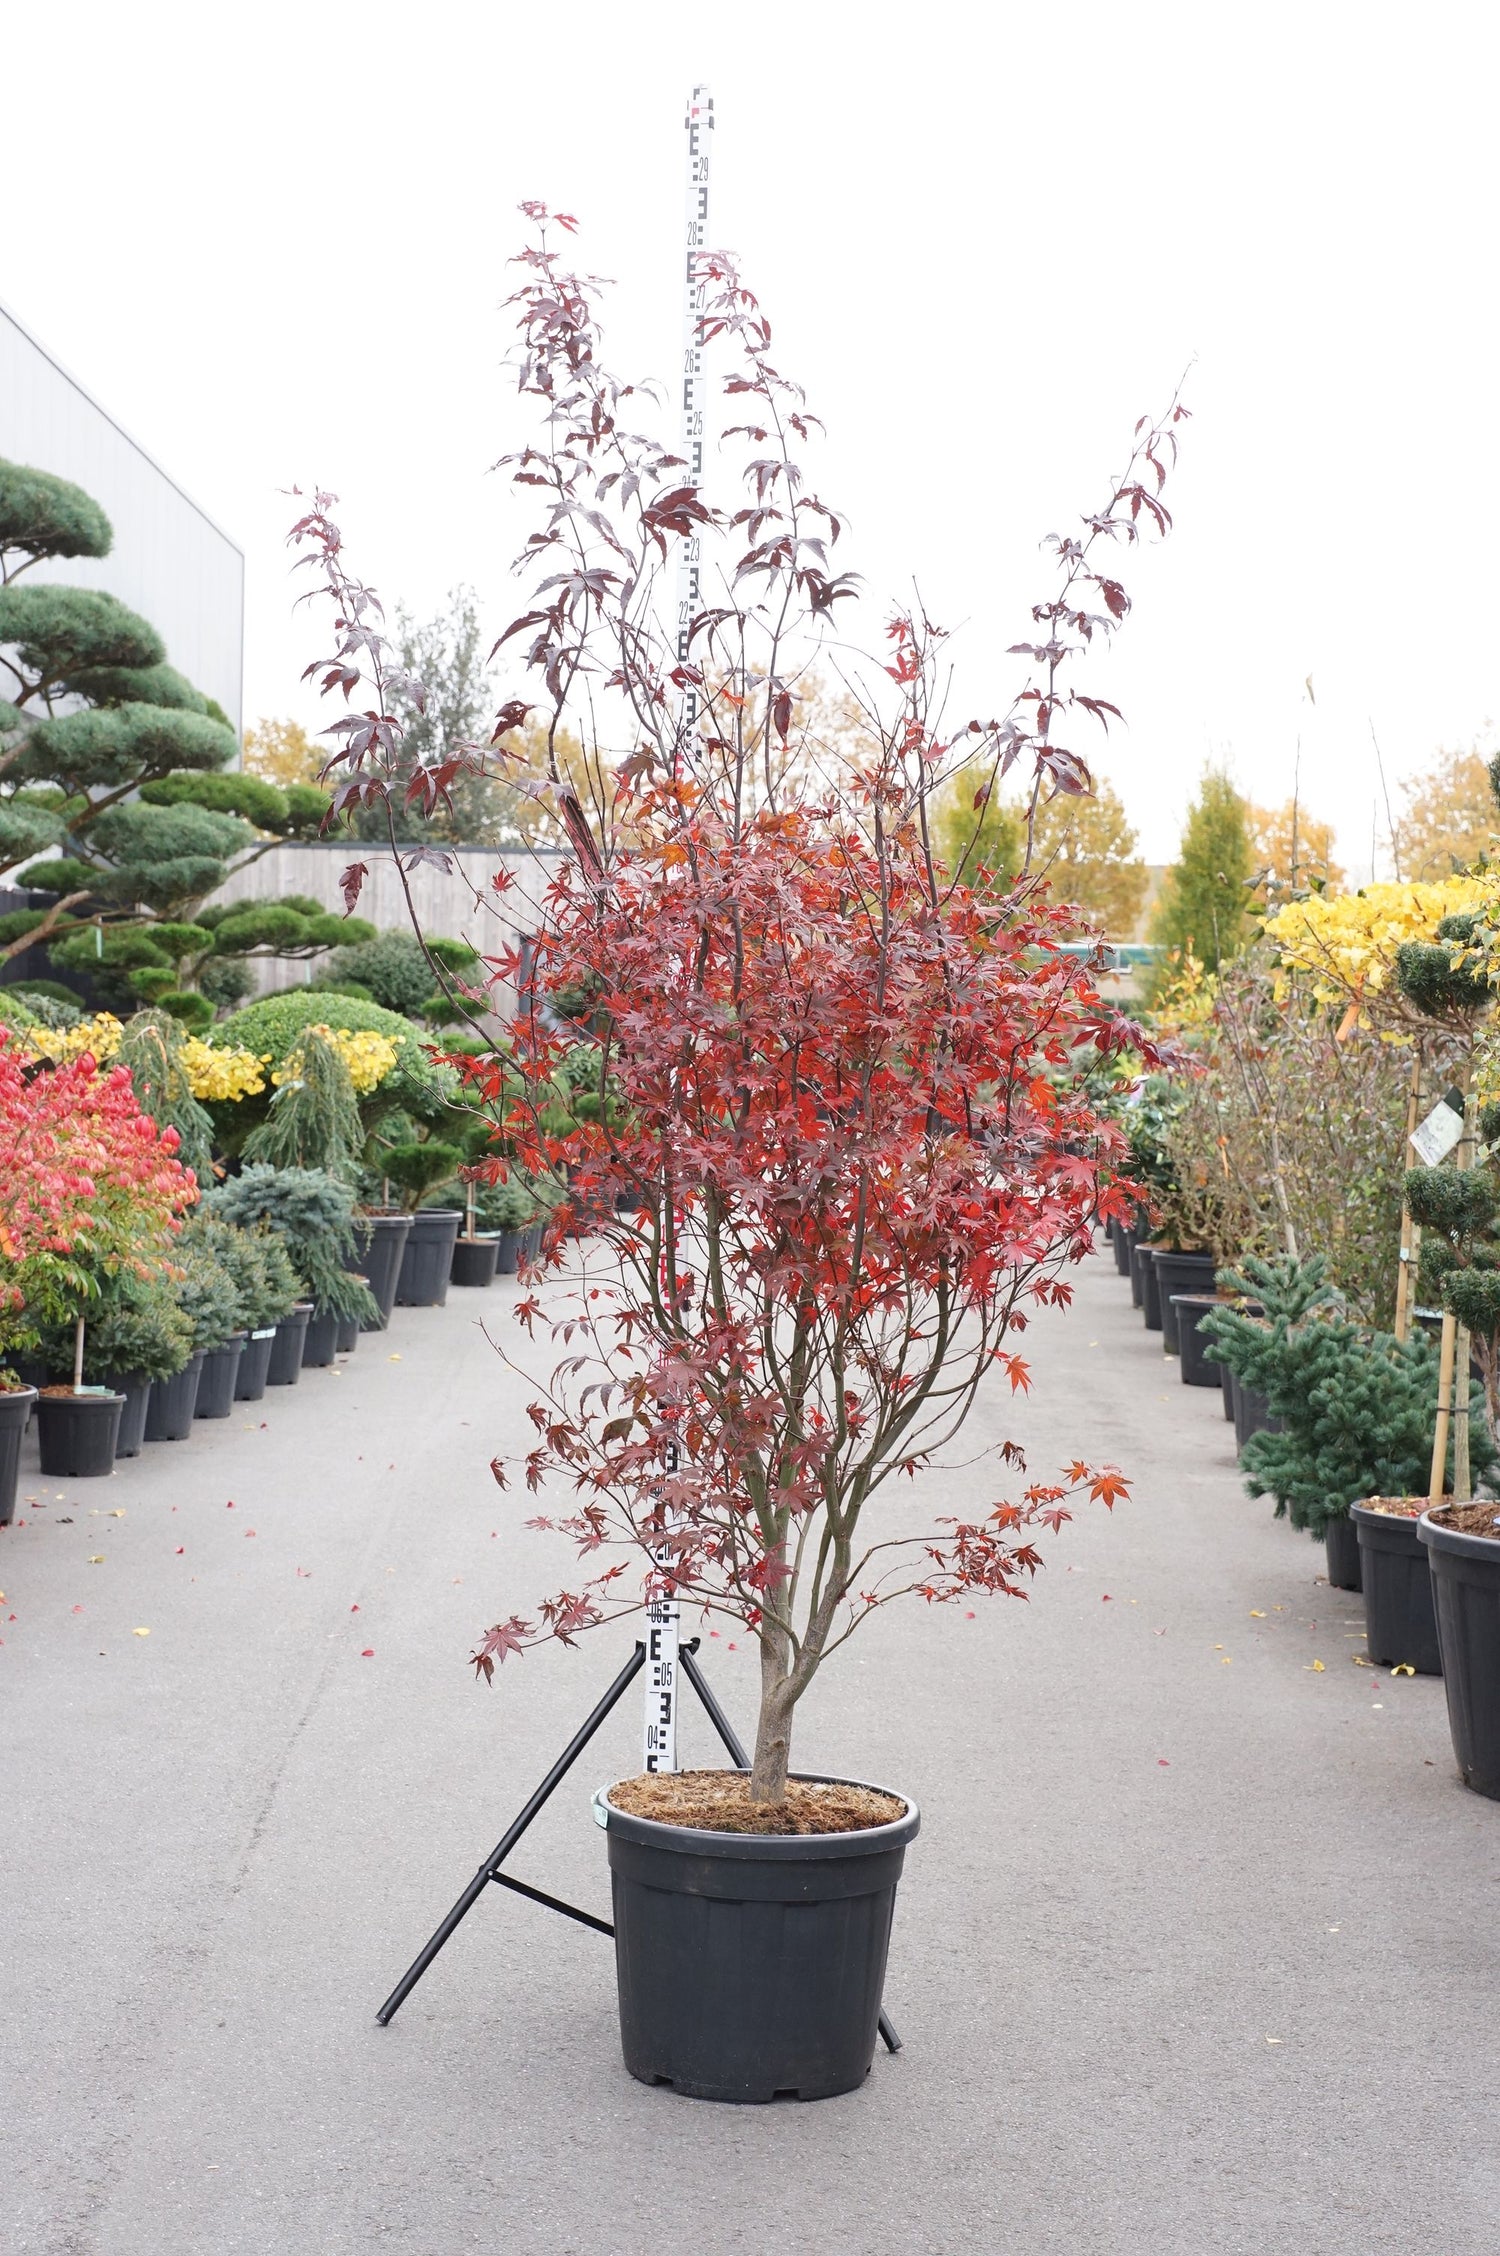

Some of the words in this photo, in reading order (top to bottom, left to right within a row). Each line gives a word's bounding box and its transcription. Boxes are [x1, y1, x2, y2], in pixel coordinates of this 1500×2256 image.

[699, 157, 708, 181] 29
[688, 221, 697, 245] 28
[685, 349, 694, 373] 26
[693, 411, 703, 435] 25
[691, 537, 700, 561] 23
[679, 601, 688, 624] 22
[661, 1662, 672, 1686] 05
[648, 1725, 658, 1749] 04
